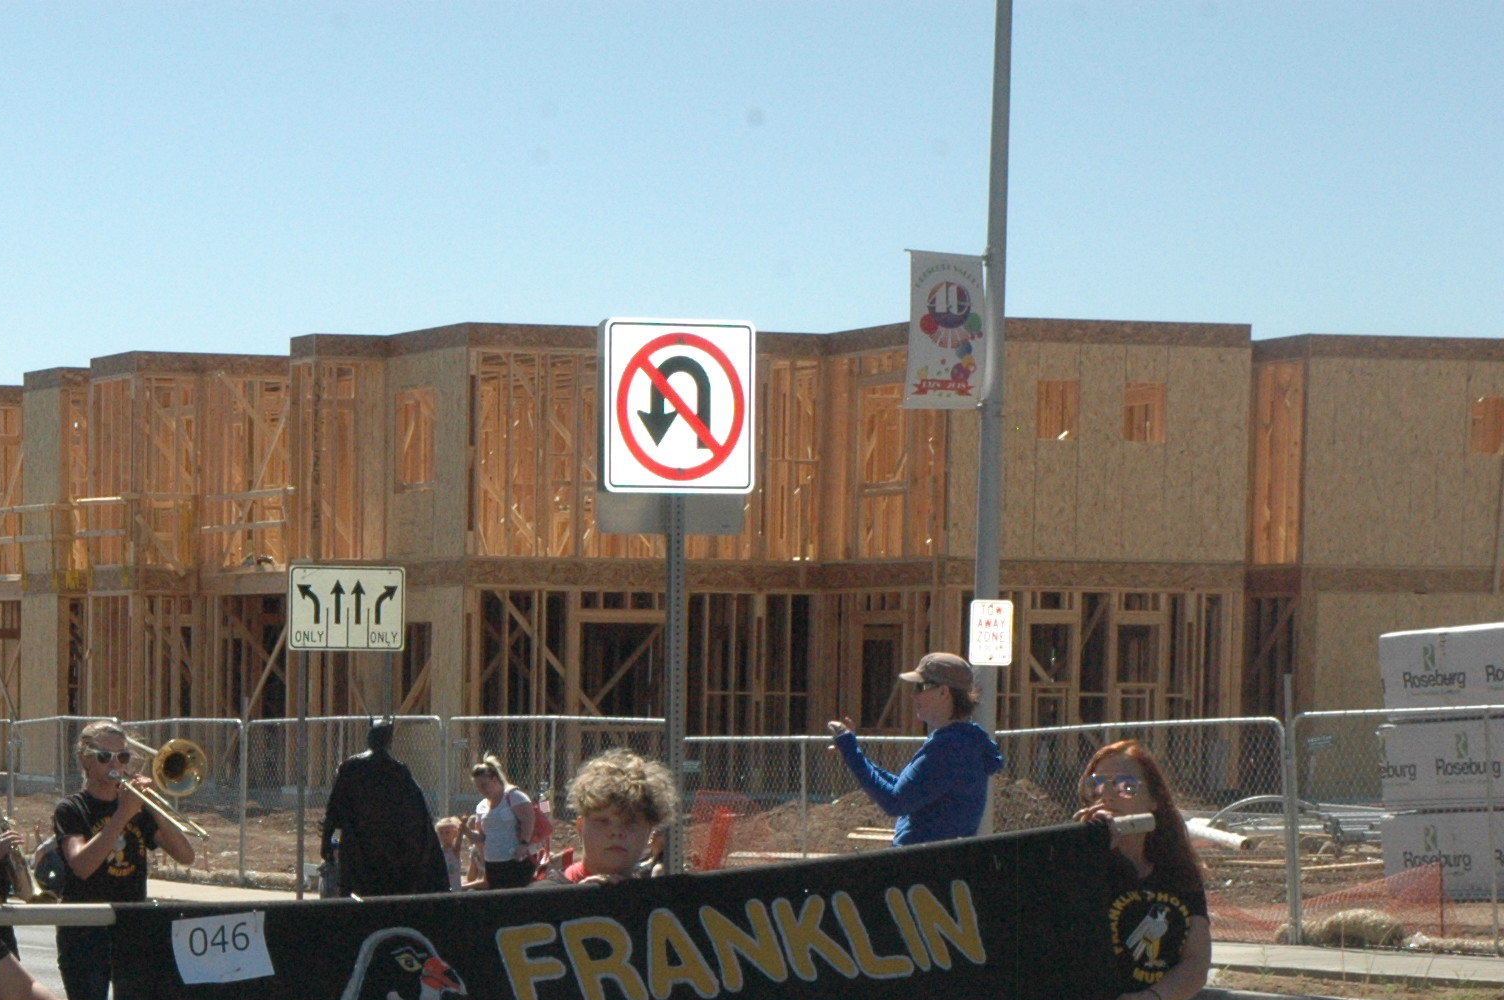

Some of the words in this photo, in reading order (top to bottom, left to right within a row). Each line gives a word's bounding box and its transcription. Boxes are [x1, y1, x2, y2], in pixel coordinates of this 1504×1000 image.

[981, 603, 1003, 615] TOW
[978, 619, 1005, 629] AWAY
[295, 630, 325, 643] ONLY
[370, 631, 398, 645] ONLY
[977, 631, 1005, 643] ZONE
[1402, 669, 1466, 689] Roseburg
[1435, 757, 1502, 779] Rosebug
[1402, 849, 1472, 872] Roseburg
[188, 921, 250, 957] 046
